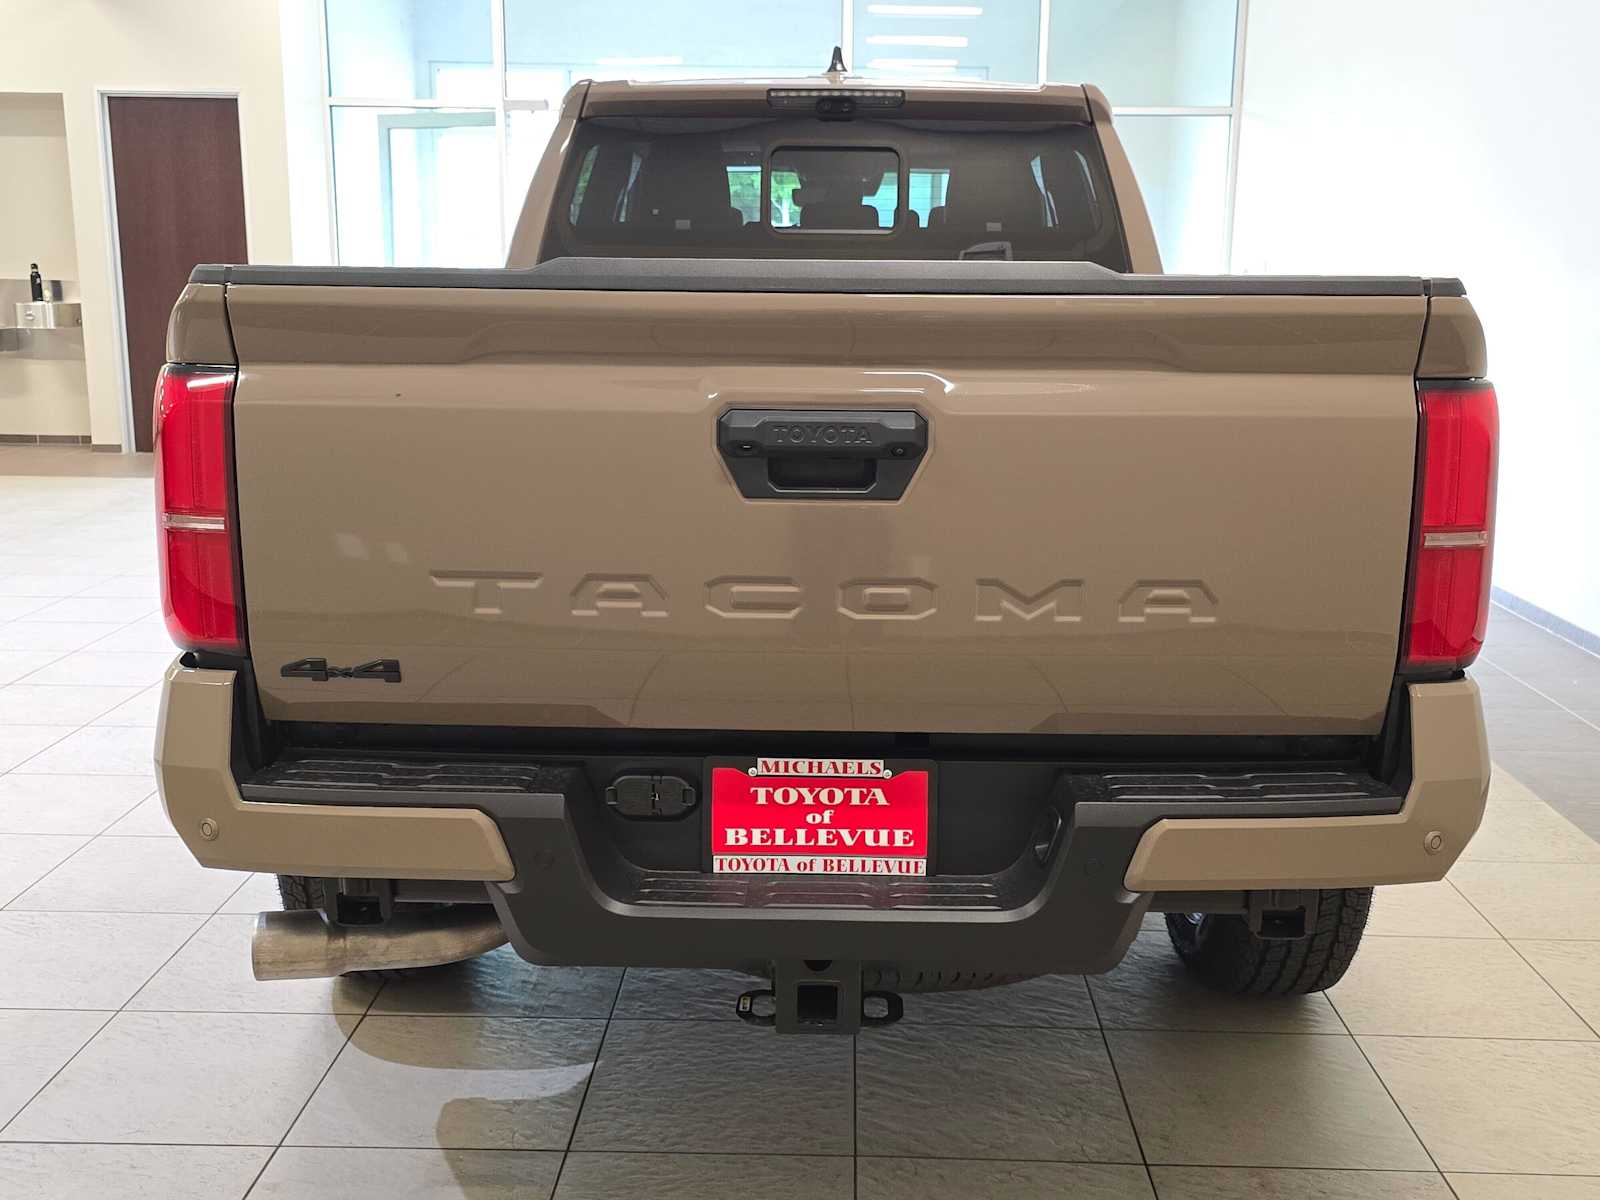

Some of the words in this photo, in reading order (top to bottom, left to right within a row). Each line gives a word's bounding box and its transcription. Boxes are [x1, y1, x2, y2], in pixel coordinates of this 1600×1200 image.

[773, 425, 873, 444] TOYOTA
[428, 569, 1219, 624] TACOMA
[760, 759, 882, 776] MICHAELS
[750, 787, 890, 806] TOYOTA
[805, 809, 835, 825] of
[724, 827, 915, 847] BELLEVUE
[715, 857, 790, 872] TOYOTA
[796, 858, 817, 873] of
[823, 858, 925, 875] BELLEVUE
